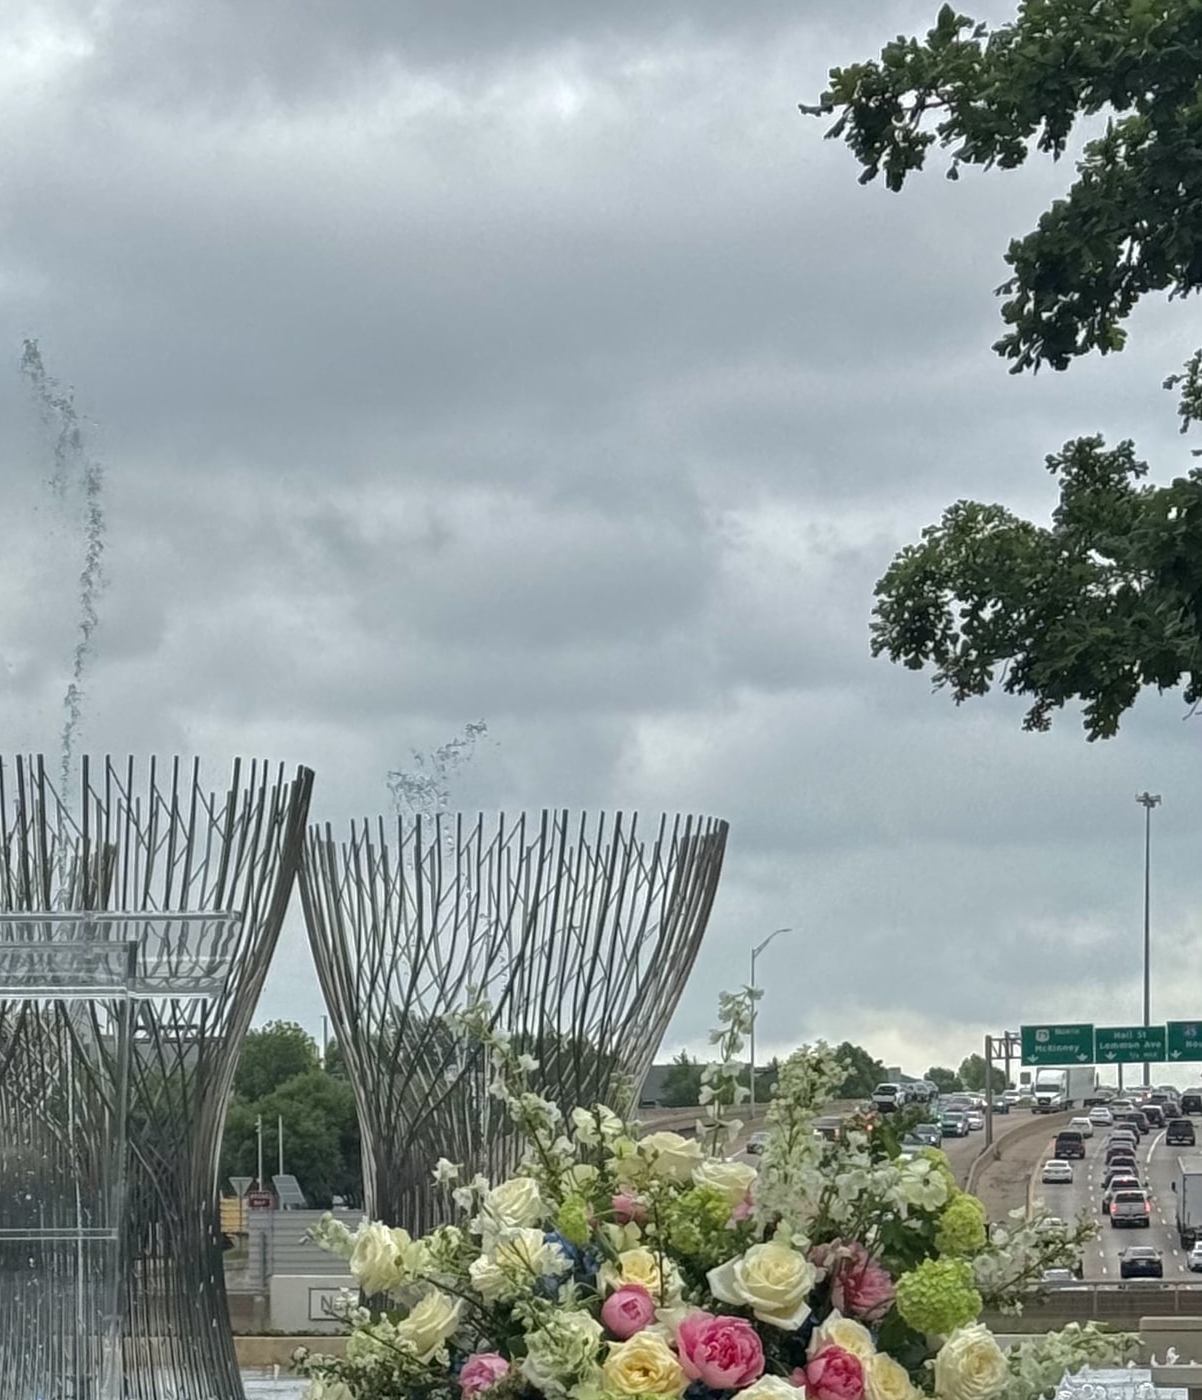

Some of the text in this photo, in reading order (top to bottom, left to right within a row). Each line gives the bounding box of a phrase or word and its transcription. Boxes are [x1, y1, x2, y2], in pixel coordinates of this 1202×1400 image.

[1114, 1031, 1147, 1039] Hall St
[1035, 1045, 1080, 1053] McKinney
[1099, 1041, 1162, 1050] Lemmon Ave
